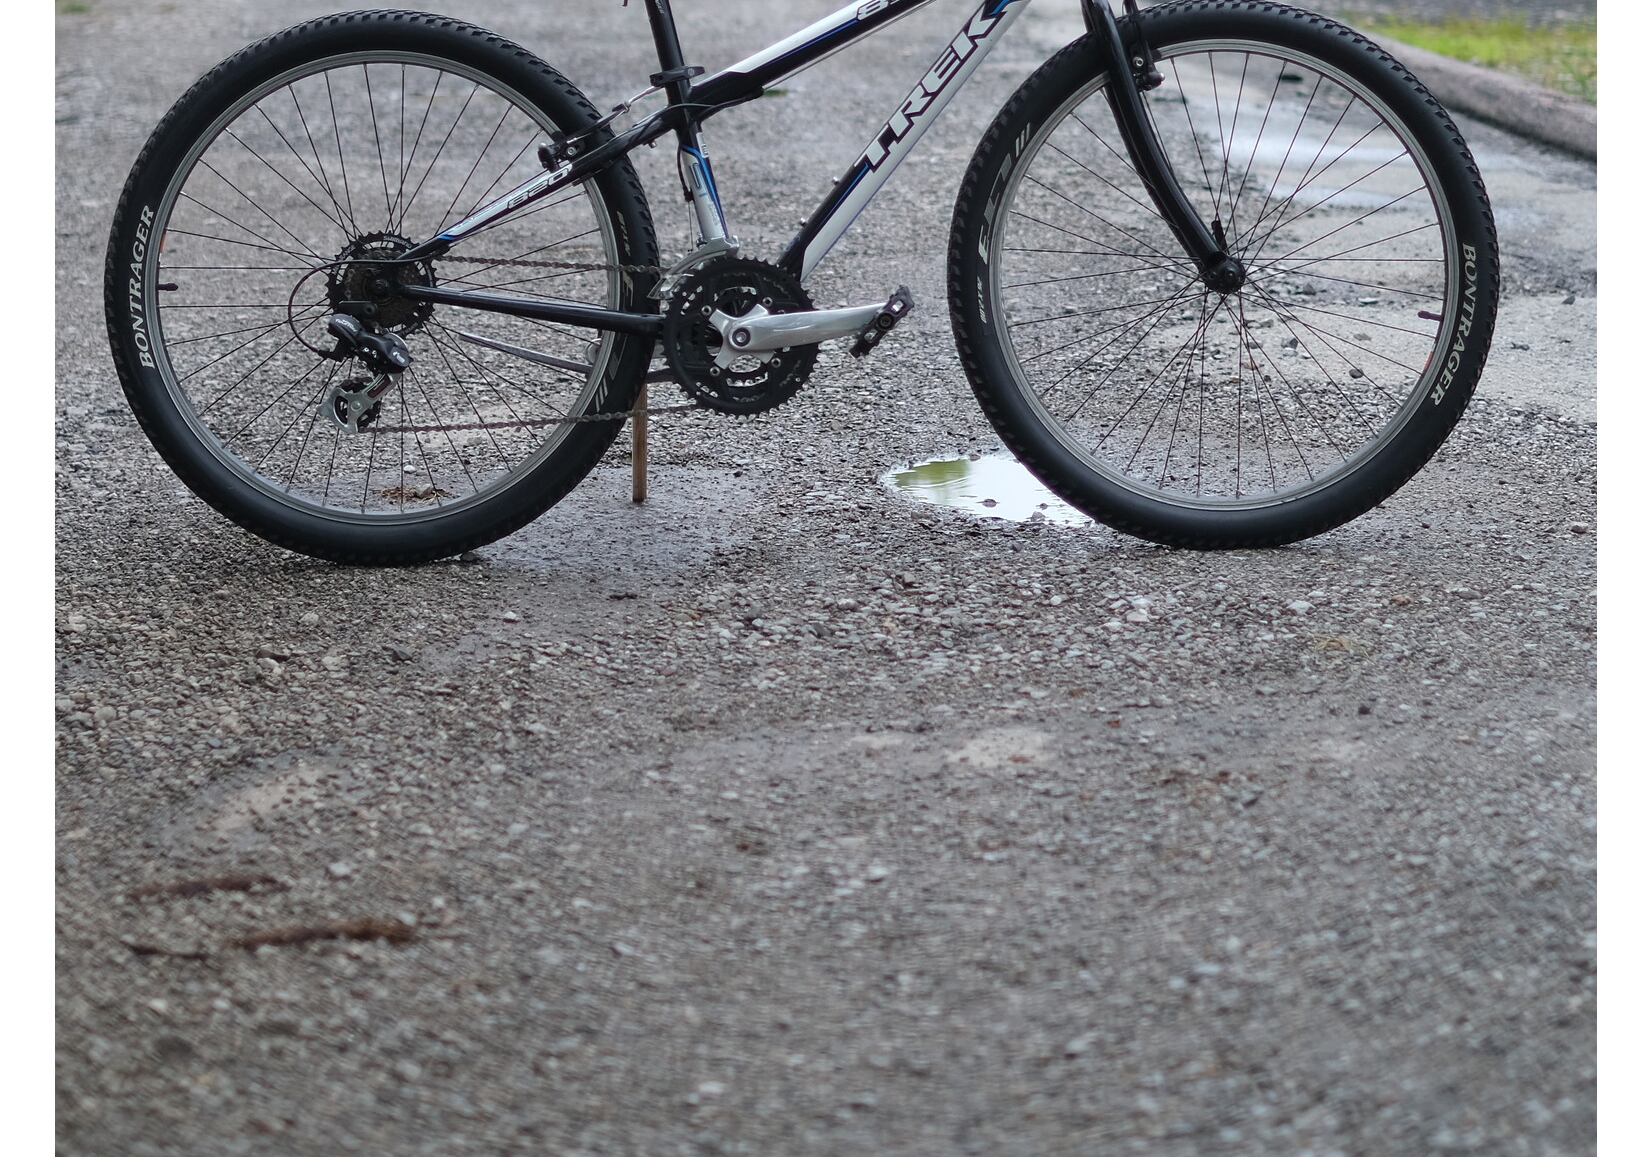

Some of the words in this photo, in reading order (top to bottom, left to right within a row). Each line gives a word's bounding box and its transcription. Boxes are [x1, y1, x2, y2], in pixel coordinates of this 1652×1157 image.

[854, 3, 1008, 174] TREK
[507, 167, 570, 209] 820
[128, 204, 156, 370] BONTRAGER
[1430, 242, 1478, 406] BONTRAGER
